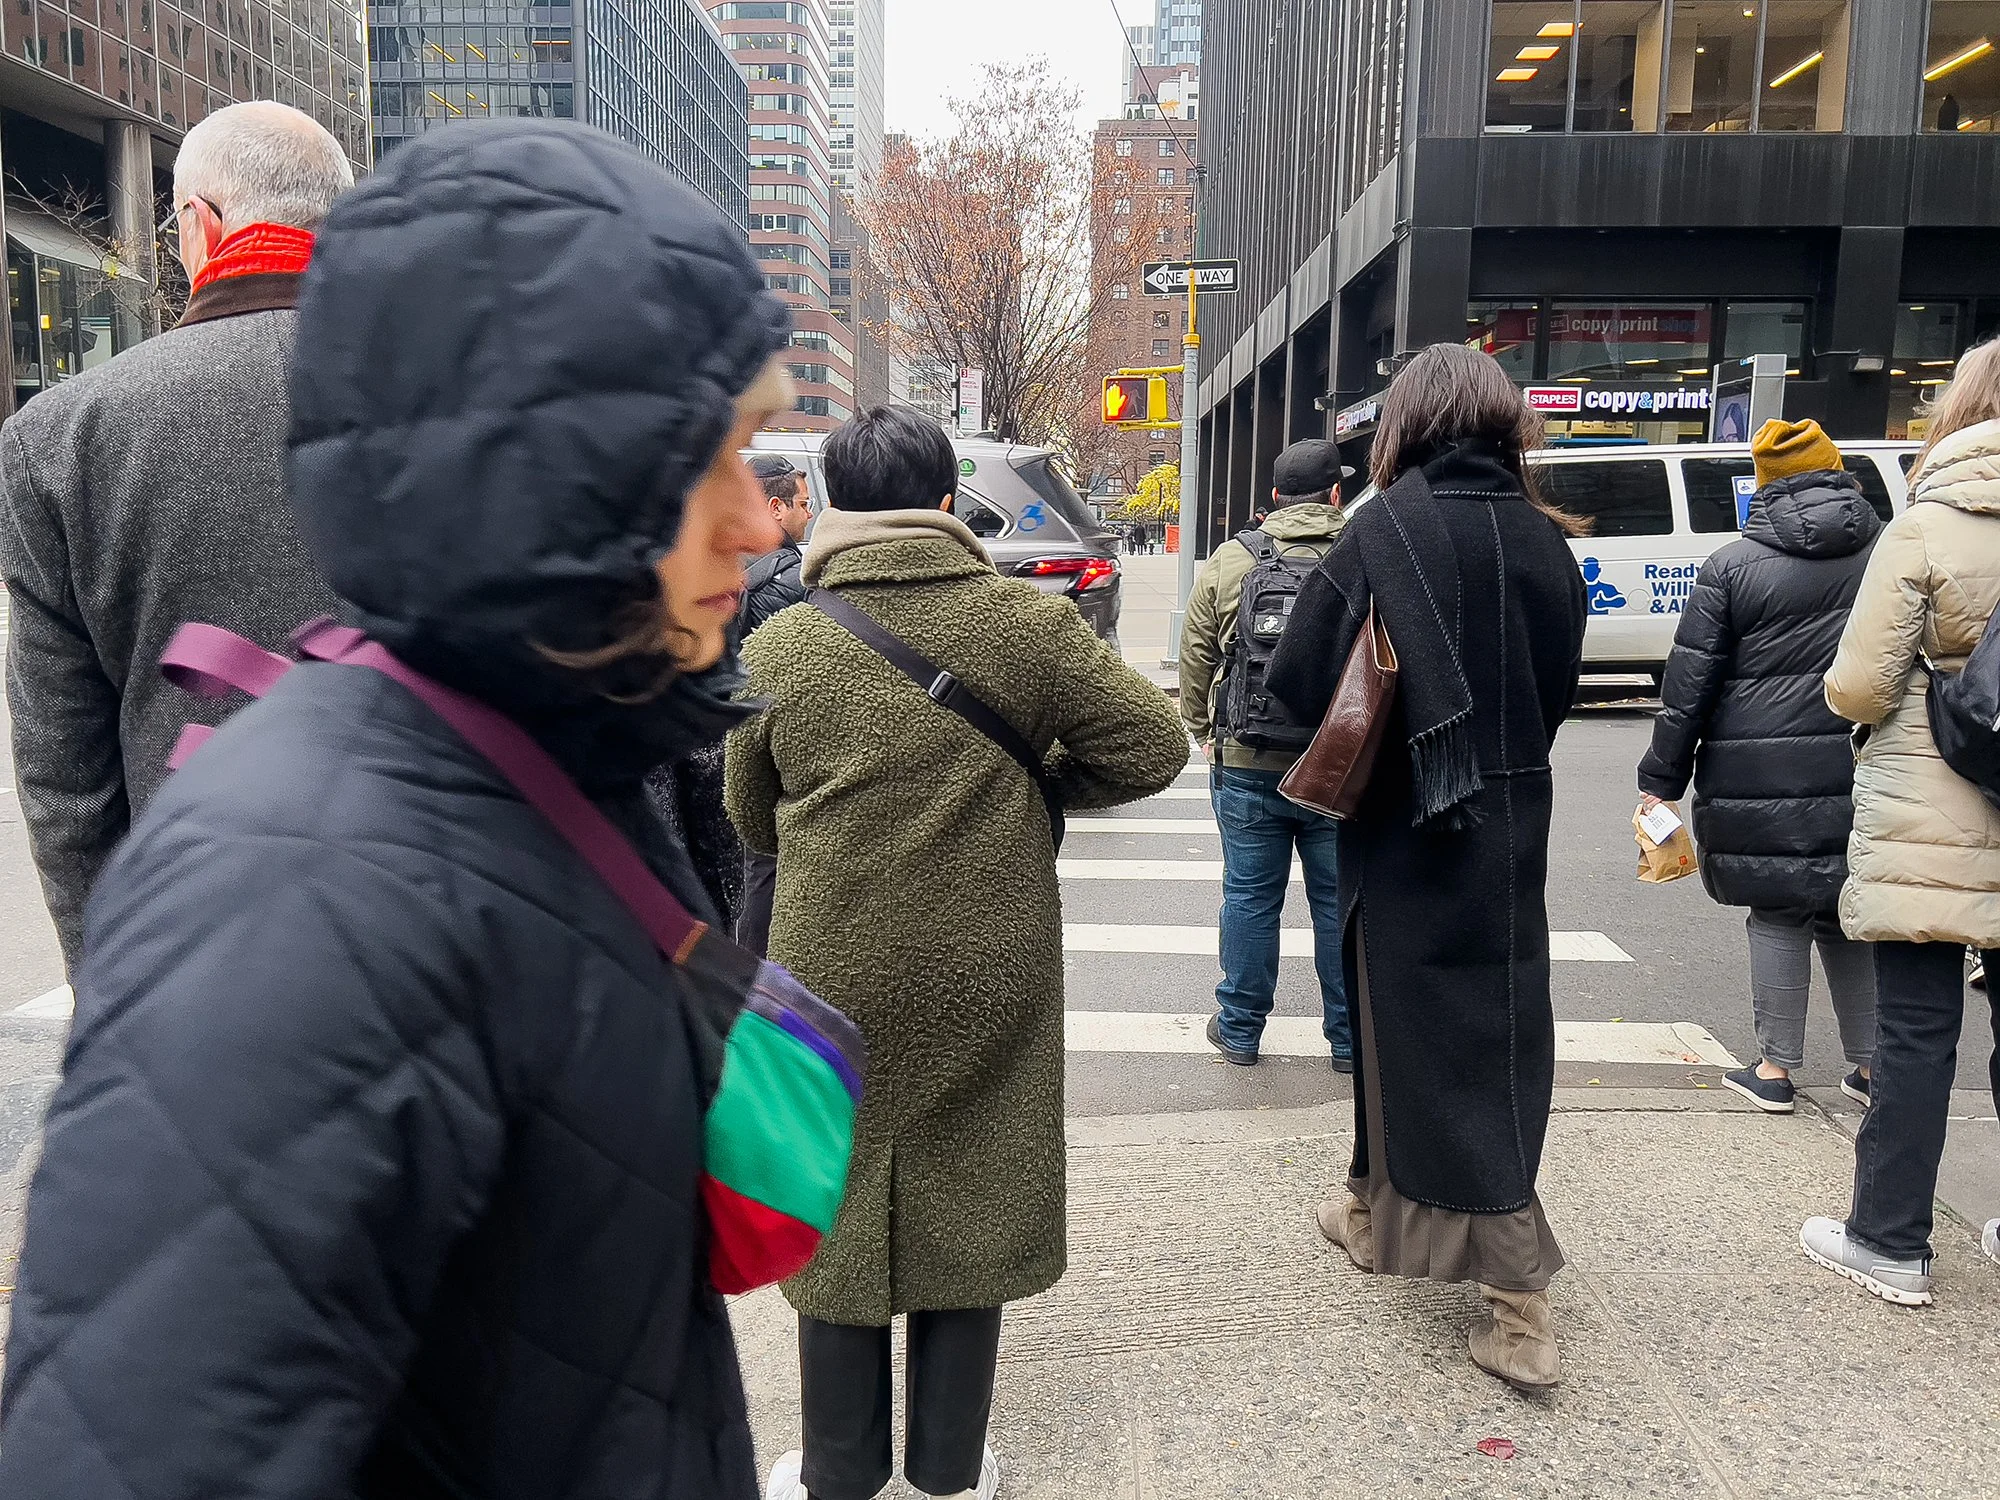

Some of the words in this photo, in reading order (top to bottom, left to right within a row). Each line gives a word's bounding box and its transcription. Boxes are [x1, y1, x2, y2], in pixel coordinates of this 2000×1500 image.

[1156, 272, 1184, 285] ONE
[1199, 269, 1230, 283] WAY
[1530, 394, 1577, 405] STAPLES
[1649, 599, 1666, 614] &
